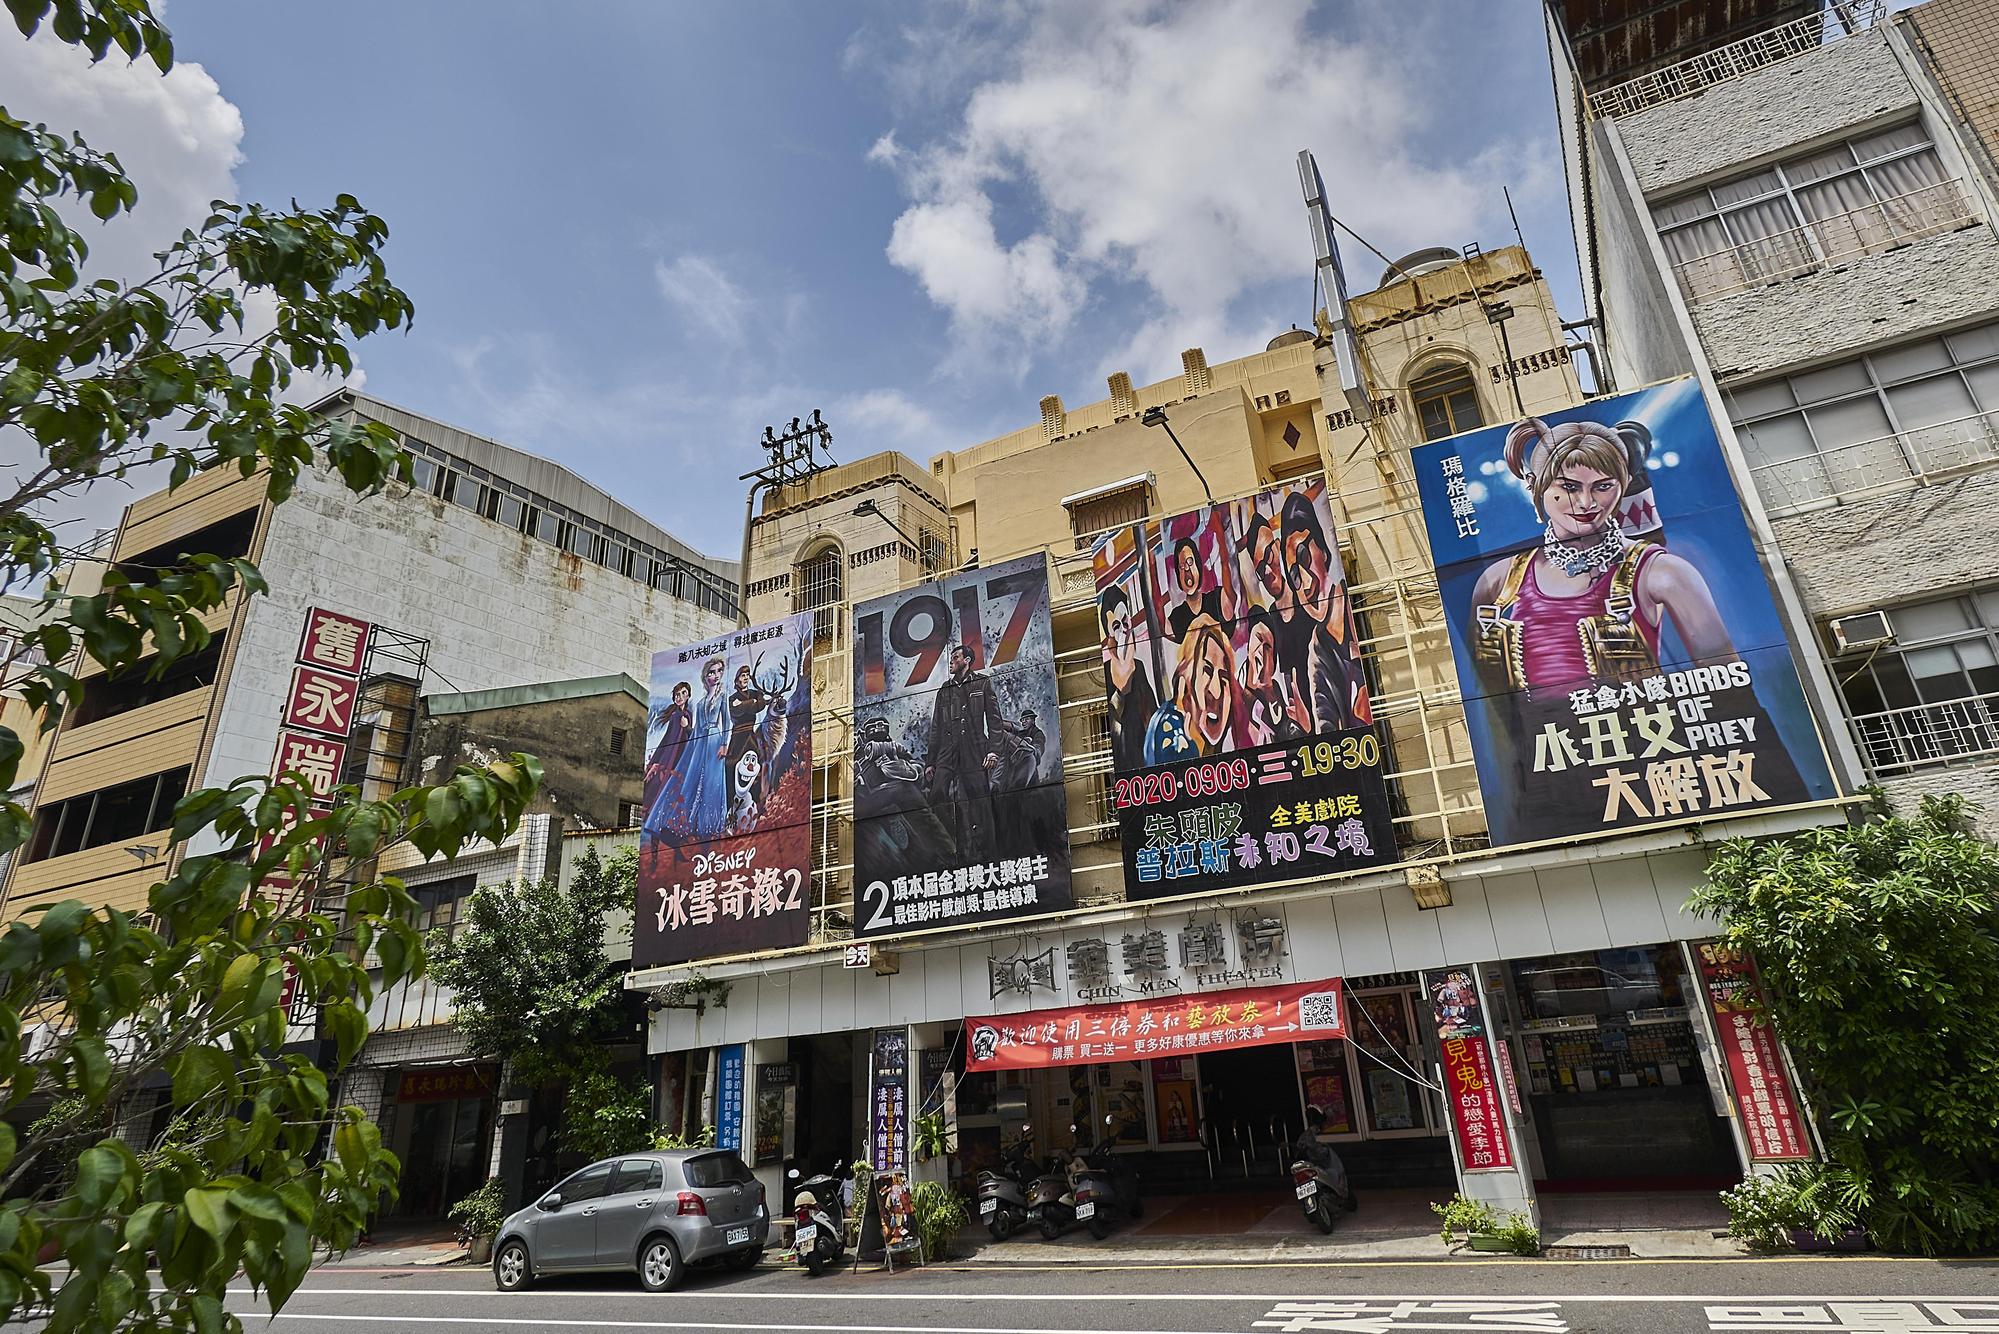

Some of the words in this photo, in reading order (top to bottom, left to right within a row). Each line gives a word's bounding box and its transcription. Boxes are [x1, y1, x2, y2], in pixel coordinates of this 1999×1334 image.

[1440, 456, 1480, 538] 瑪格羅比
[734, 624, 784, 648] 尋找魔法起源
[858, 566, 1047, 696] 1917
[1568, 674, 1674, 716] 猛禽小隊
[1668, 661, 1752, 698] BIRDS
[1676, 695, 1714, 724] OF
[1532, 702, 1691, 774] 小丑女
[1684, 716, 1757, 751] PREY
[1591, 748, 1773, 823] 大解放
[1143, 802, 1243, 850] 朱頭皮
[1269, 793, 1363, 829] 全美戲院
[1140, 977, 1182, 994] MEN
[1051, 1045, 1075, 1061] 購票
[1080, 1041, 1128, 1059] 買二送一
[1133, 1024, 1266, 1054] 更多好康優惠等你來拿
